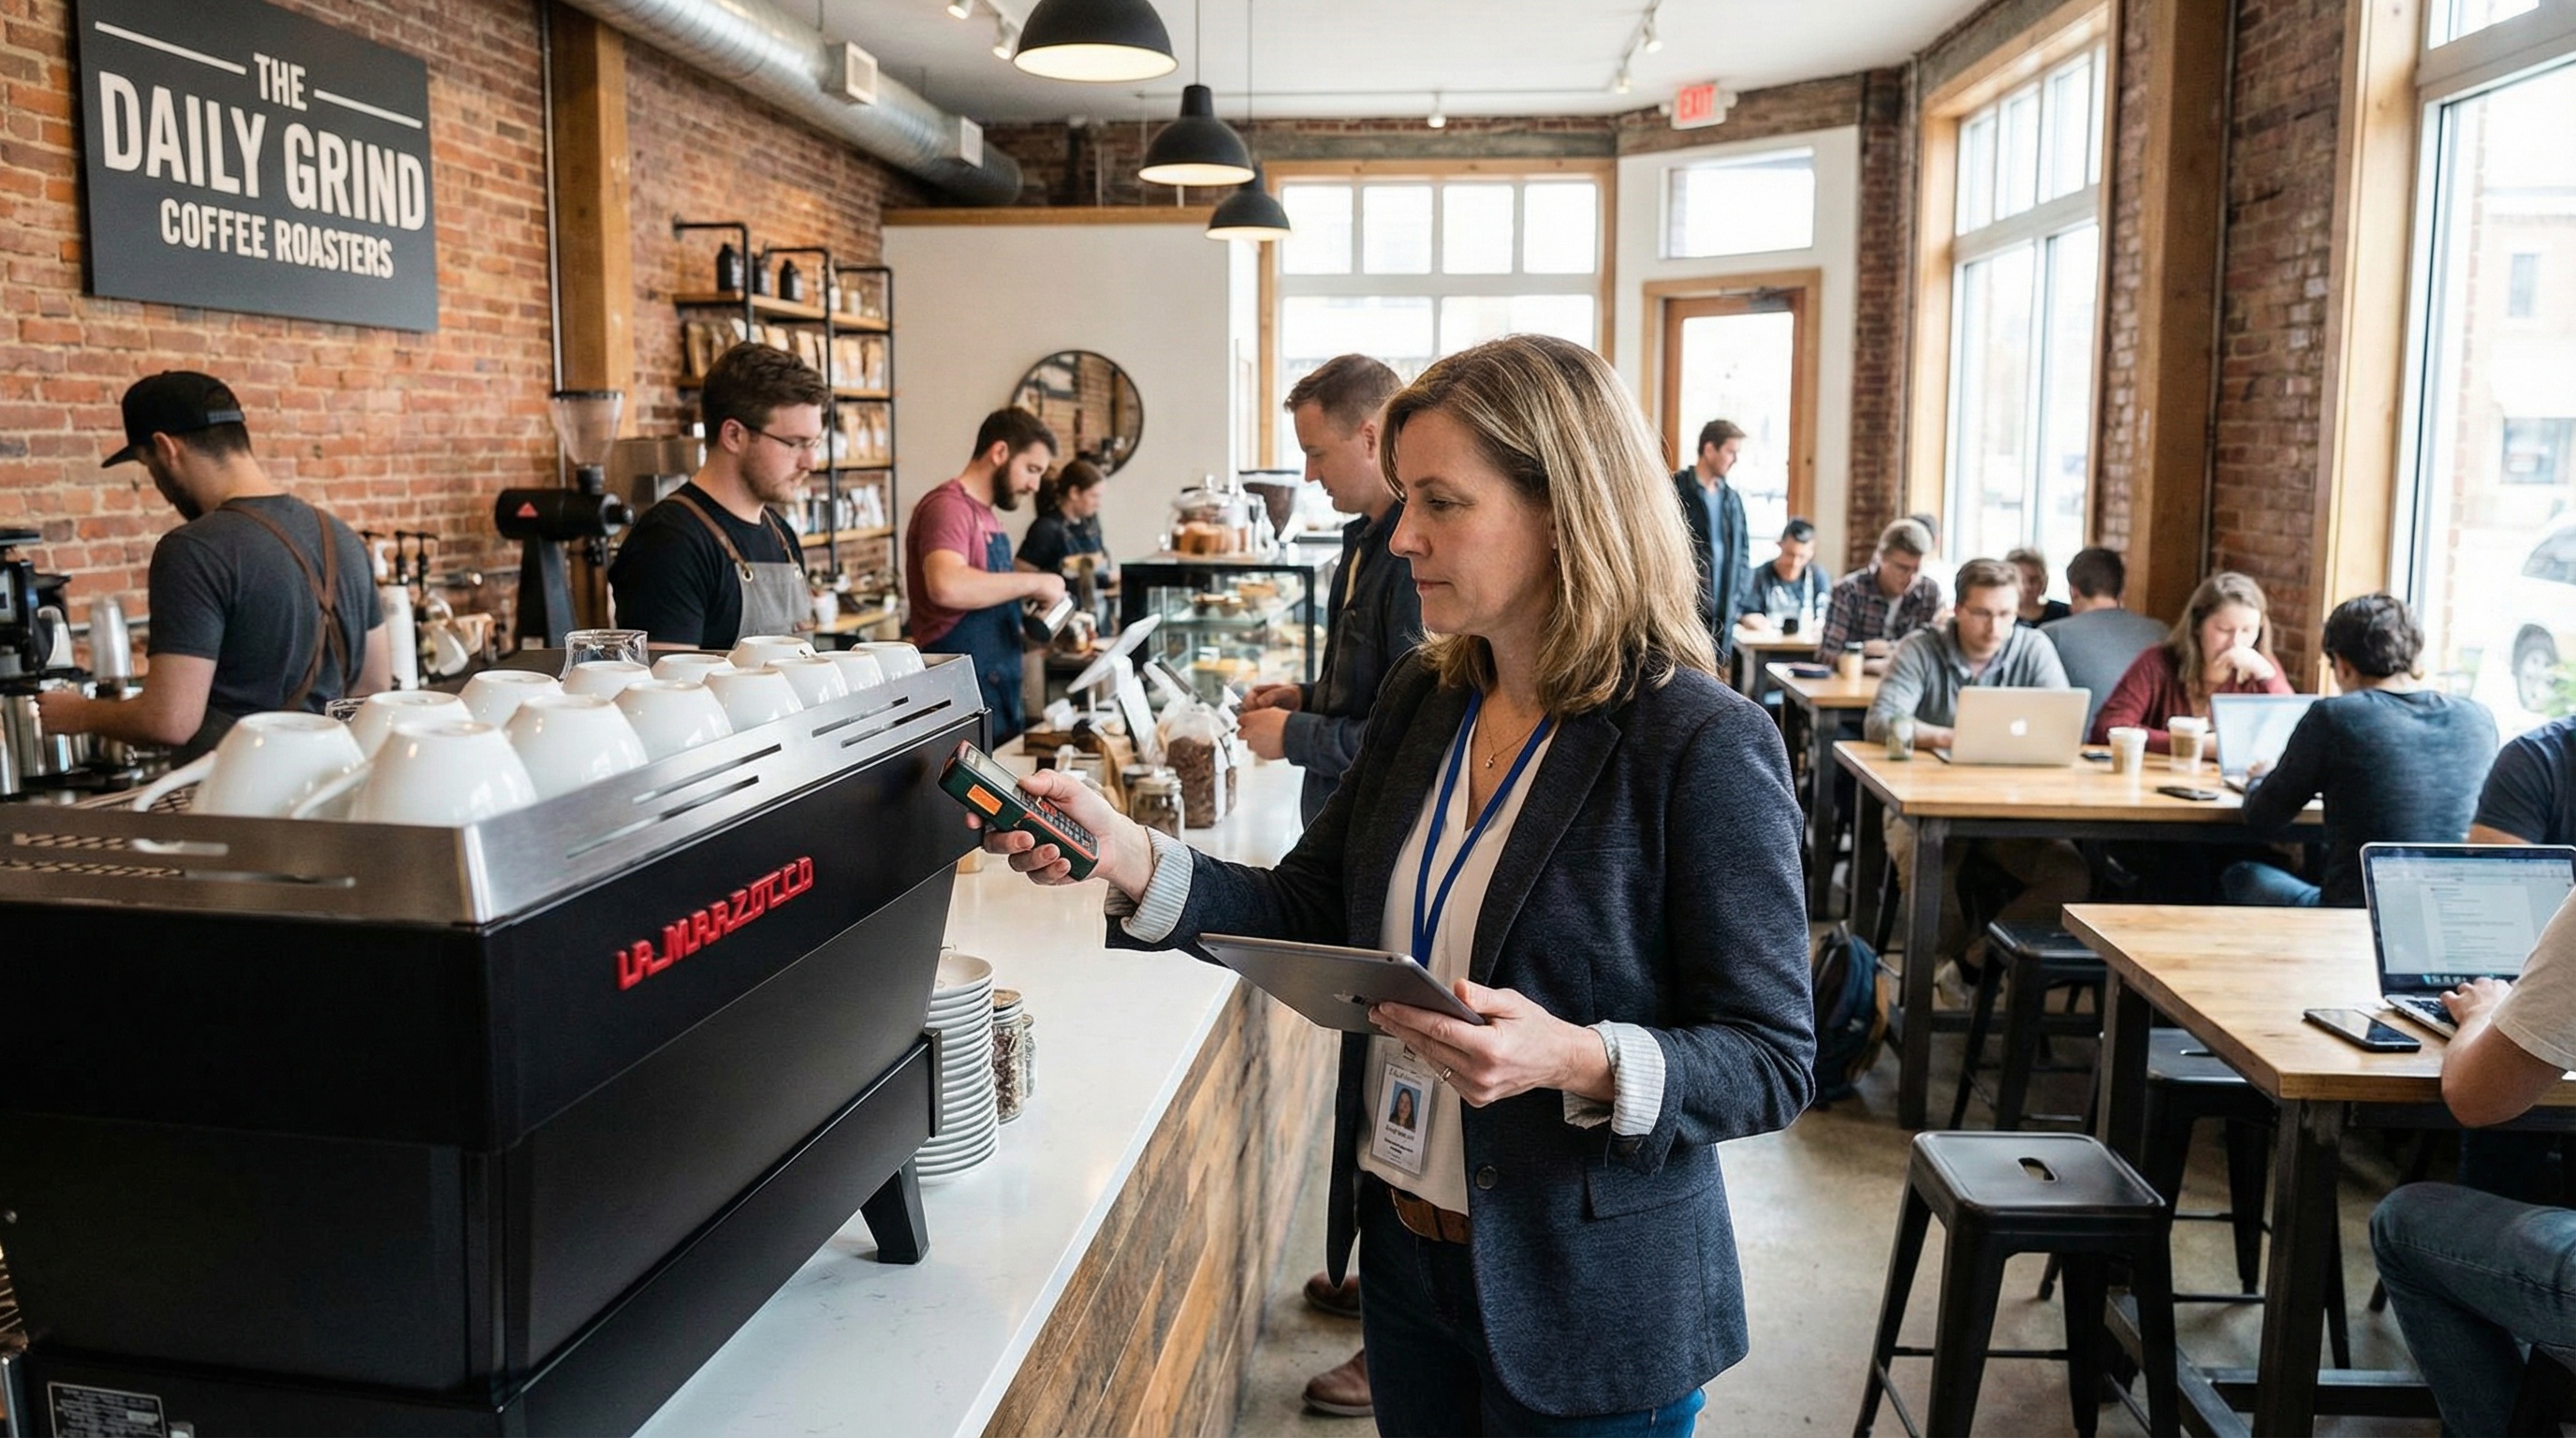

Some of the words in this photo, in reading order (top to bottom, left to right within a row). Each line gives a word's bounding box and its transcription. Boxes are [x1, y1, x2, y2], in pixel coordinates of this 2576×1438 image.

[253, 52, 307, 111] THE
[1678, 85, 1714, 120] EXIT
[99, 70, 267, 198] DAILY
[284, 123, 426, 231] GRIND
[160, 198, 269, 259] COFFEE
[274, 218, 394, 279] ROASTERS
[617, 939, 657, 991] LA
[660, 856, 814, 964] MARZOCCO
